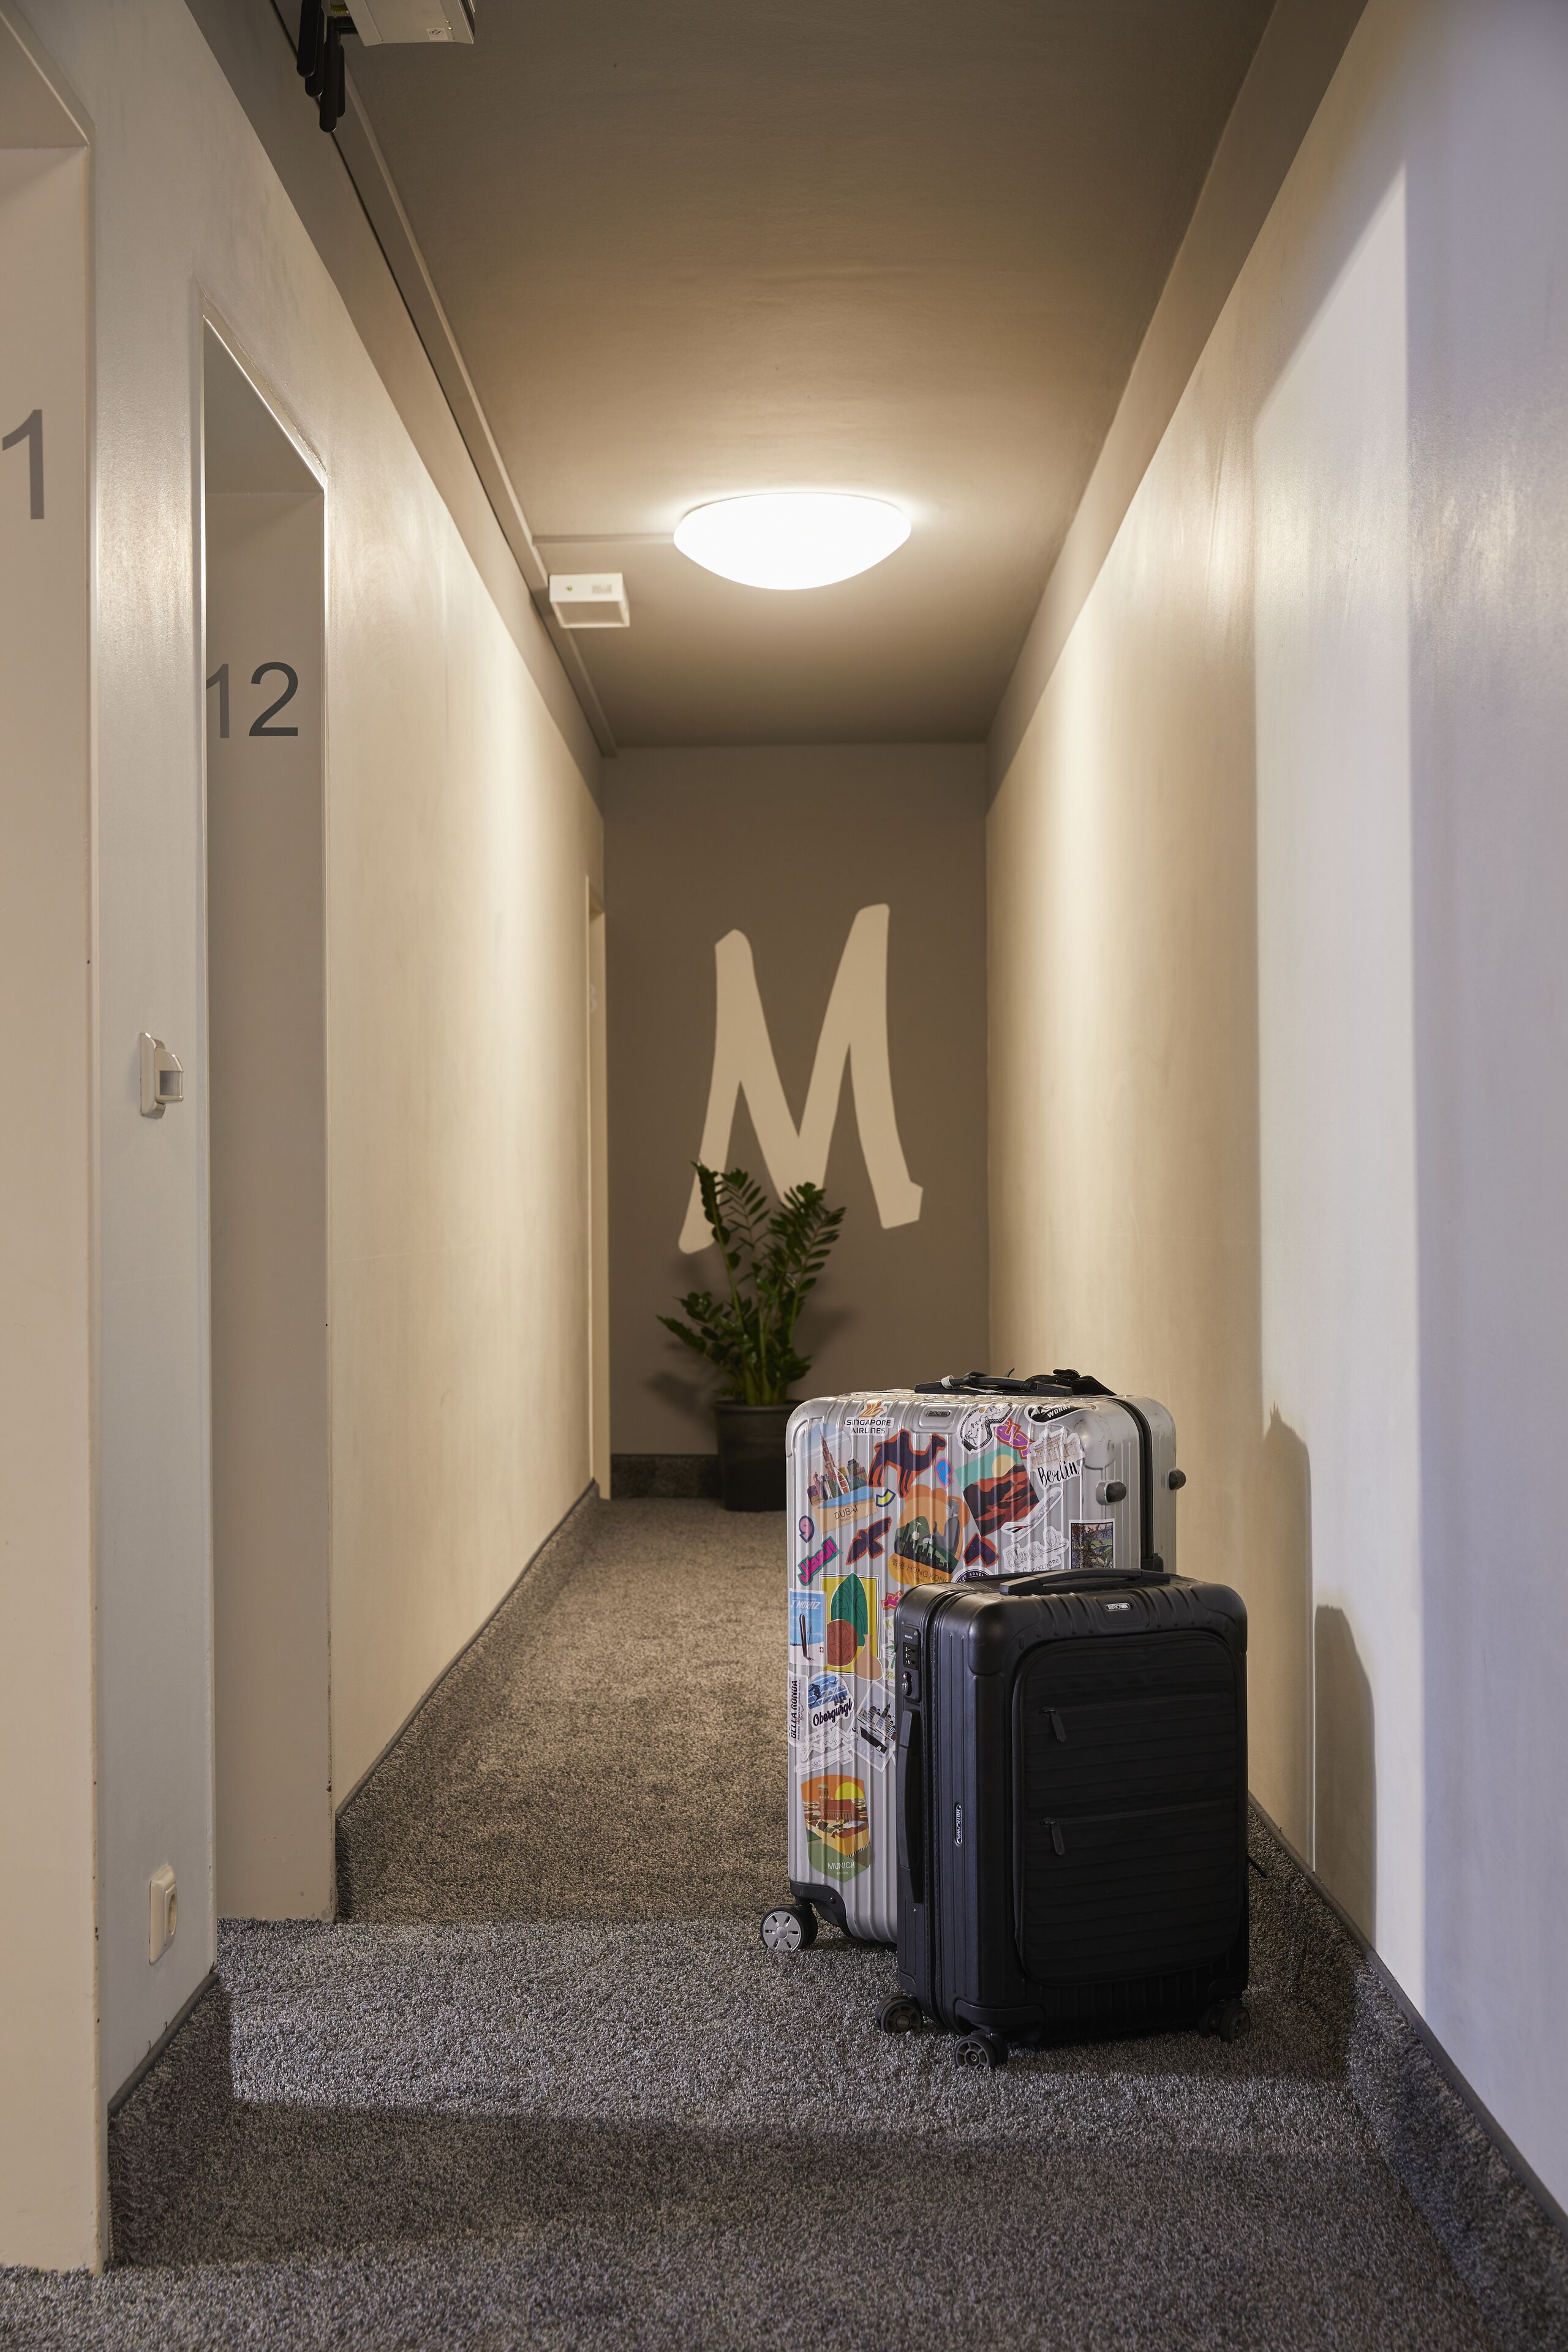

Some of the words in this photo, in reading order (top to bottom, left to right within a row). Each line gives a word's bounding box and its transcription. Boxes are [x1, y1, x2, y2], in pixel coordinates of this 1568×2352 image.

[2, 409, 44, 519] 1
[206, 662, 298, 739] 12
[678, 903, 923, 1254] M
[1047, 1404, 1071, 1418] WORRY
[1037, 1460, 1080, 1488] Berlin
[834, 1505, 858, 1520] DUBAI
[907, 1564, 928, 1578] HONG
[796, 1600, 821, 1610] MORITZ
[813, 1698, 853, 1727] Obergurgl
[827, 1861, 855, 1870] MUNICH
